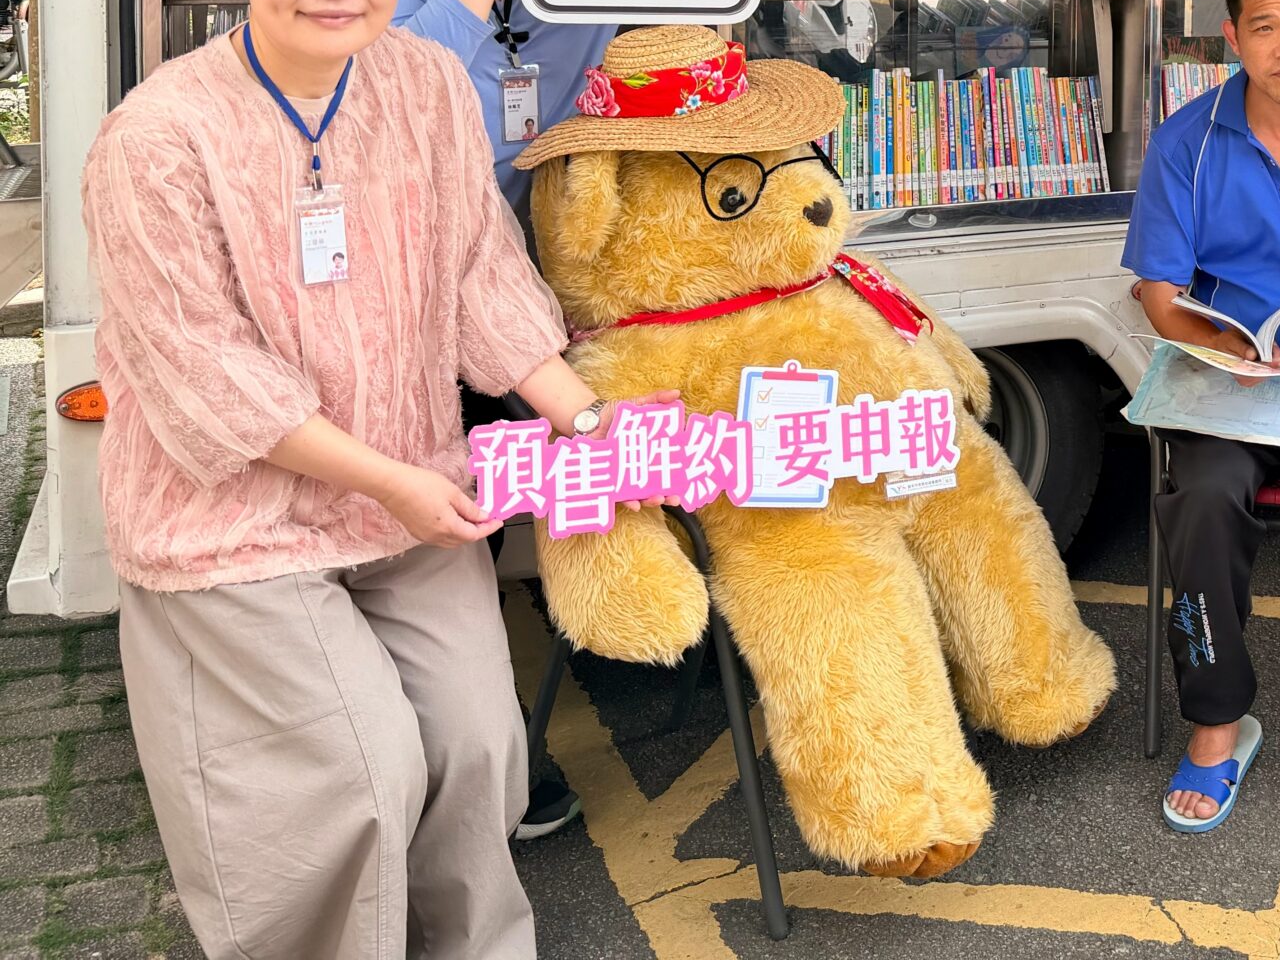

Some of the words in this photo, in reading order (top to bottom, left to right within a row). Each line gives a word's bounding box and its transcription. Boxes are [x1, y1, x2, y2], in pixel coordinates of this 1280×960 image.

[473, 406, 750, 531] 預售解約
[773, 395, 956, 488] 要申報
